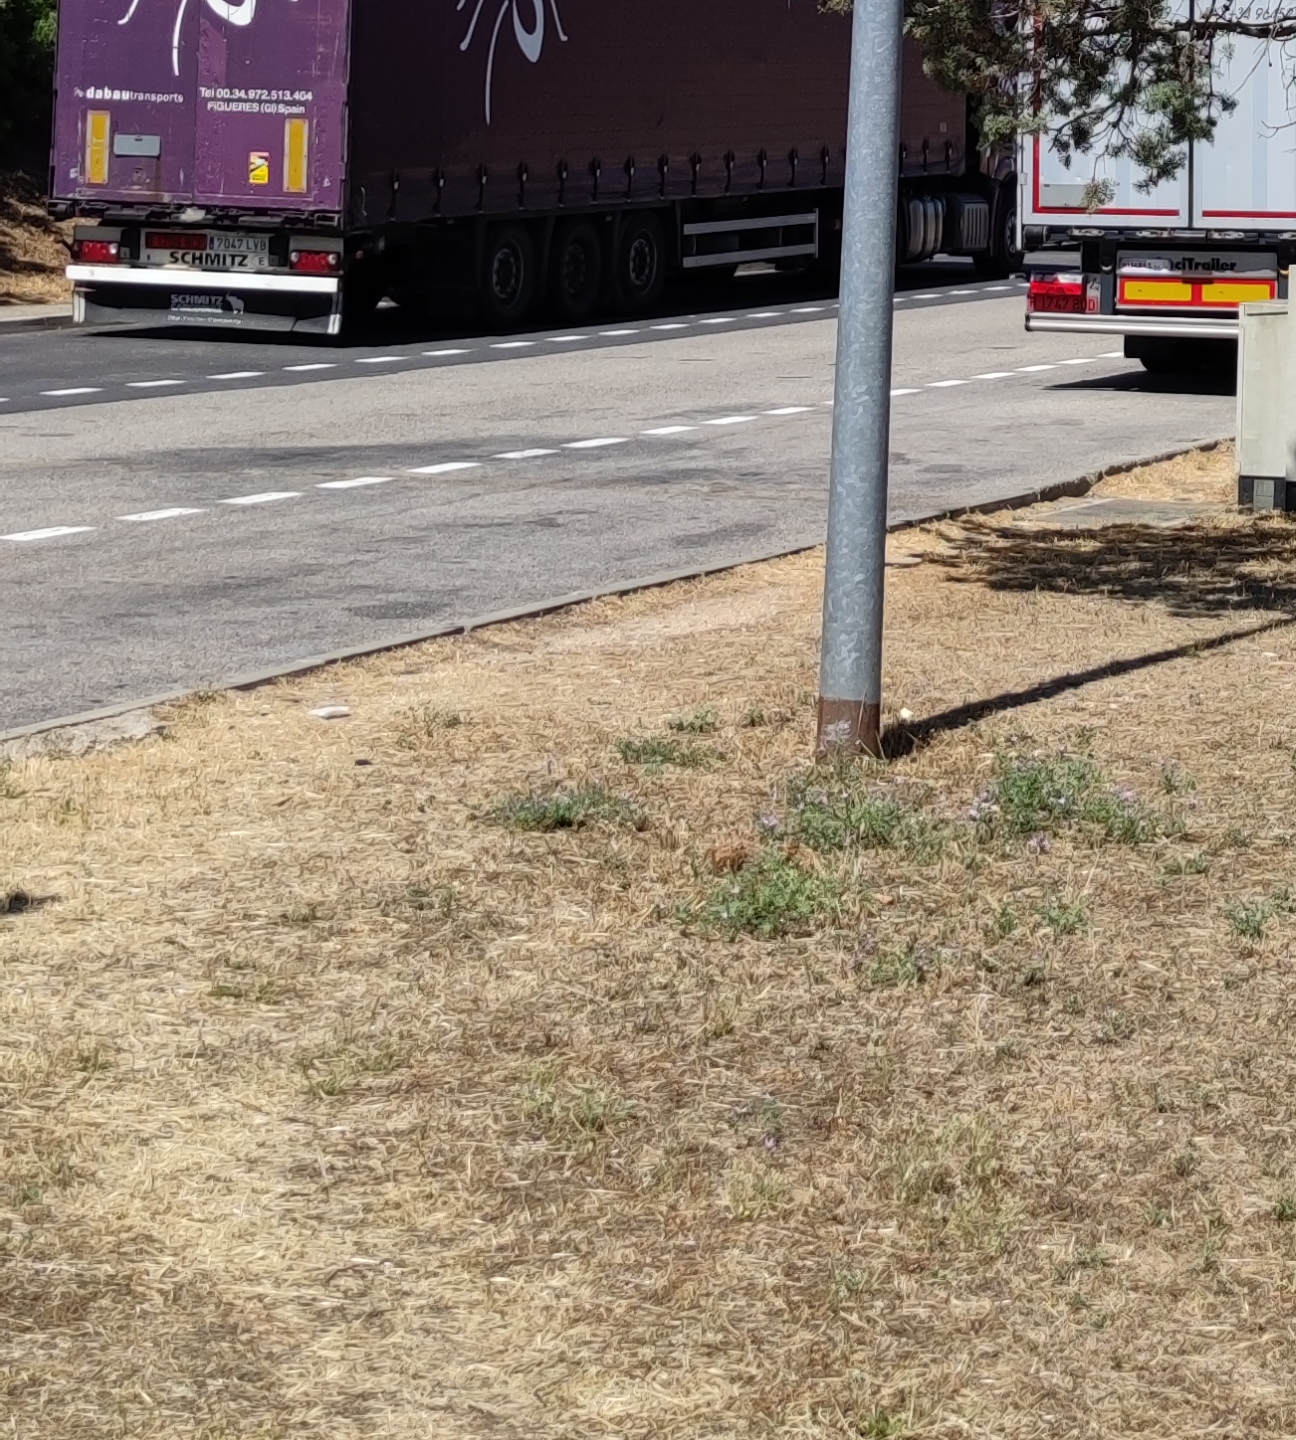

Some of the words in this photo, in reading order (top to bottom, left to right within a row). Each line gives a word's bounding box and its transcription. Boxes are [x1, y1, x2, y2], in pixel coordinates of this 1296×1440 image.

[278, 103, 305, 116] Spain
[217, 237, 243, 250] 7047
[169, 251, 249, 267] SCHMITZ
